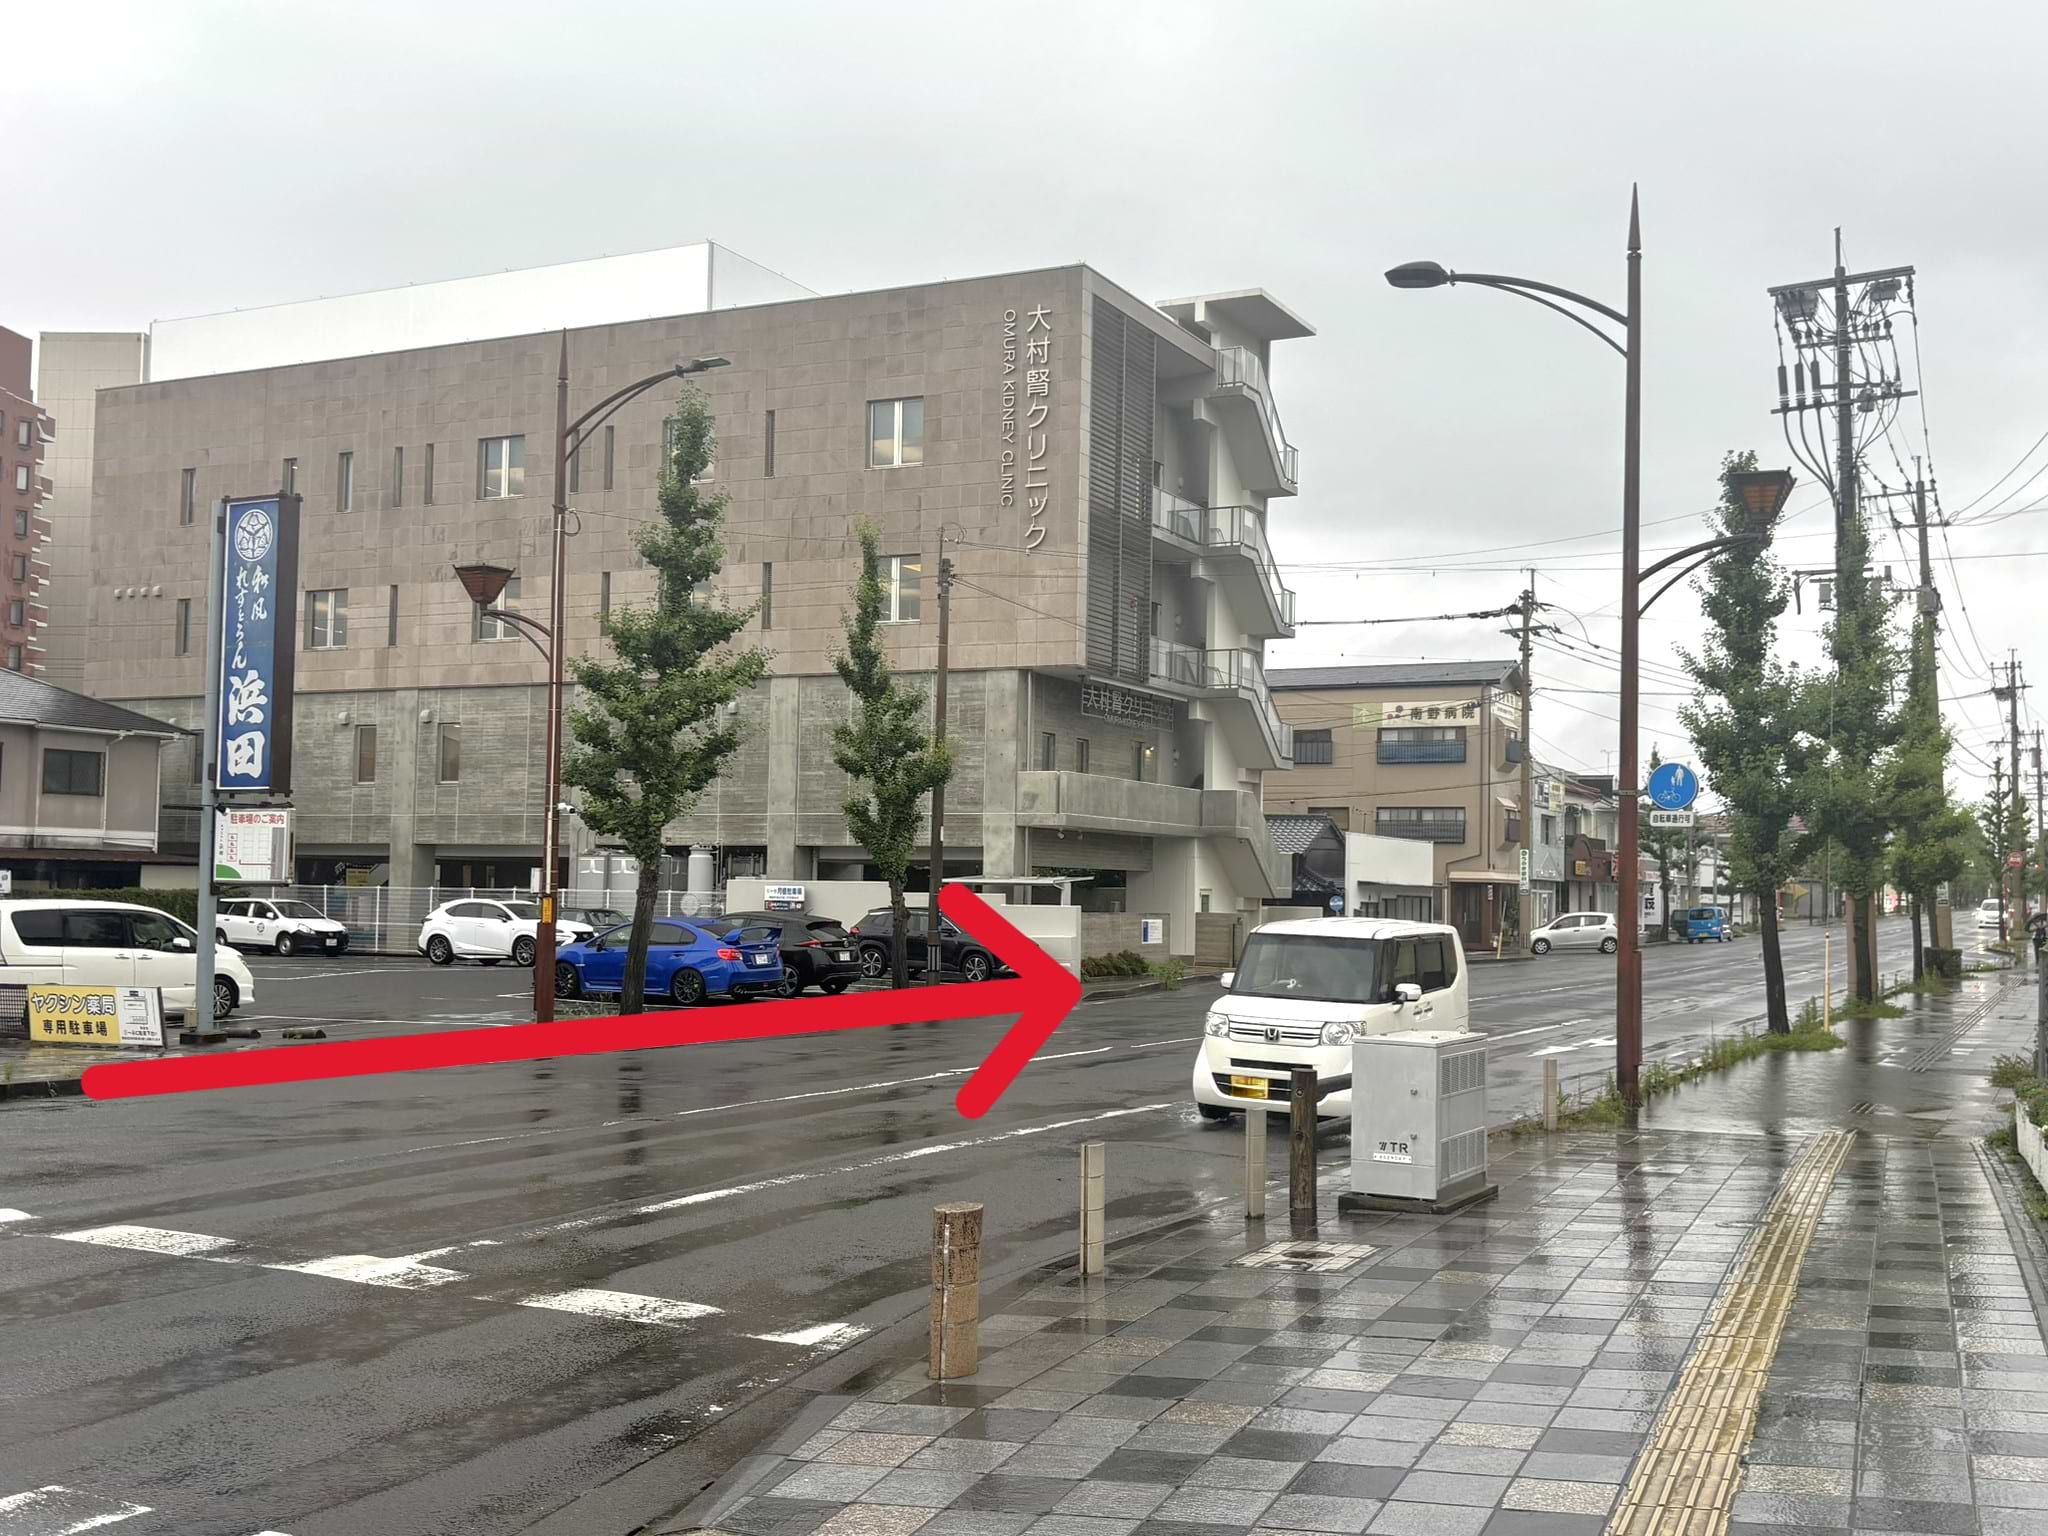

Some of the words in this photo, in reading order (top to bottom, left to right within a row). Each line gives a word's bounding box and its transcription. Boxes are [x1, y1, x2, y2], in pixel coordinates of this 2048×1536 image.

[1003, 308, 1016, 375] OMURA
[1002, 380, 1016, 444] KIDNEY
[1025, 303, 1052, 550] 大村腎クリニック
[1000, 449, 1014, 506] CLINIC
[251, 565, 269, 621] 和風
[227, 669, 268, 778] 浜田
[1410, 703, 1475, 720] 南野病院
[230, 813, 285, 825] 駐車場のご案内
[1652, 813, 1691, 824] 自転車通行可
[31, 992, 116, 1015] ヤクシン薬局
[42, 1018, 107, 1036] 専用駐車場
